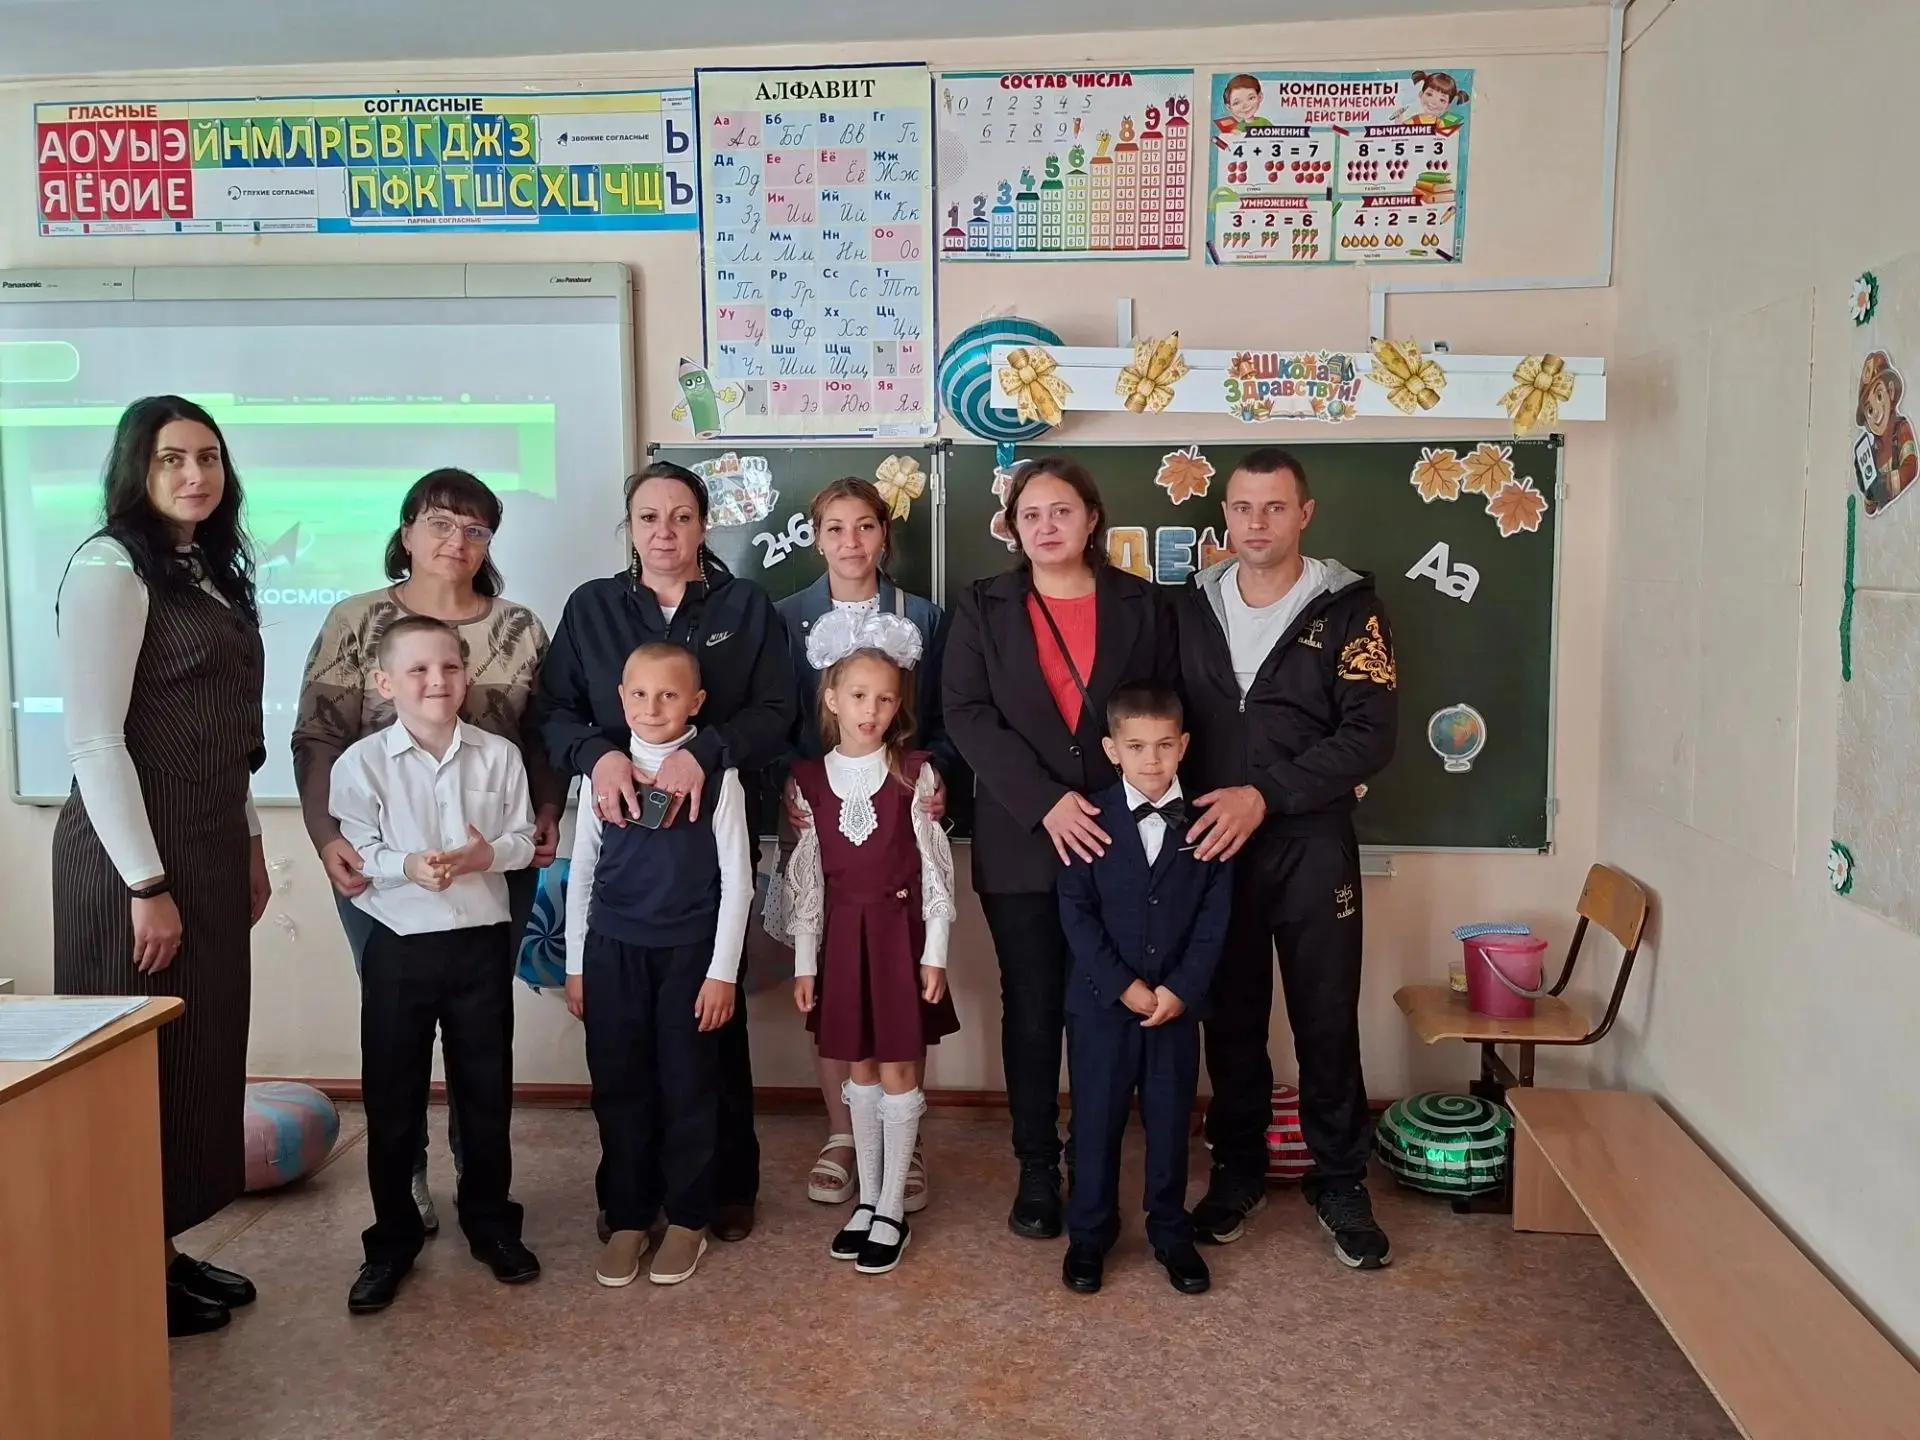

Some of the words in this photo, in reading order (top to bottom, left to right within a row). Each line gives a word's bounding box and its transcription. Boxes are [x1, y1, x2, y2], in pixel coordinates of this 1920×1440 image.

[1000, 75, 1067, 89] СОСТАВ
[1072, 73, 1133, 88] ЧИСЛА
[755, 80, 875, 100] АЛФАВИТ
[1280, 82, 1398, 95] КОМПОНЕНТЫ
[364, 99, 483, 113] СОГЛАСНЫЕ
[958, 97, 968, 111] 0
[986, 97, 992, 111] 1
[1008, 96, 1018, 110] 2
[1033, 96, 1043, 110] 3
[1059, 96, 1067, 109] 4
[1083, 95, 1092, 108] 5
[1165, 98, 1189, 116] 10
[1281, 96, 1395, 108] МАТЕМАТИЧЕСКИХ
[68, 105, 157, 119] ГЛАСНЫЕ
[714, 116, 730, 125] Аа
[765, 114, 782, 125] Бб
[820, 113, 834, 123] Вв
[873, 112, 885, 122] Гг
[1145, 106, 1161, 130] 9
[1305, 111, 1370, 123] ДЕЙСТВИЙ
[605, 133, 649, 141] СОГЛАСНЫЕ
[666, 120, 689, 153] Ь
[983, 124, 992, 138] 6
[1009, 124, 1017, 137] 7
[1033, 123, 1042, 137] 8
[1059, 123, 1067, 136] 9
[1119, 119, 1135, 142] 8
[1250, 128, 1306, 136] СЛОЖЕНИЕ
[1370, 126, 1431, 136] ВЫЧИТАНИЕ
[1096, 133, 1112, 156] 7
[1233, 145, 1243, 158] 4
[1272, 145, 1280, 157] 3
[1309, 145, 1318, 157] 7
[1359, 144, 1368, 156] 8
[1395, 143, 1404, 156] 5
[1434, 142, 1443, 155] 3
[714, 155, 734, 166] Дд
[767, 154, 781, 163] Ее
[821, 151, 836, 163] Ёё
[874, 151, 898, 161] Жж
[1068, 148, 1085, 168] 6
[1045, 158, 1060, 178] 5
[1020, 170, 1036, 191] 4
[666, 172, 693, 205] Ъ
[997, 183, 1012, 204] 3
[716, 195, 731, 204] Зз
[768, 194, 784, 203] Ии
[822, 189, 839, 201] Йй
[874, 191, 891, 200] Кк
[1243, 199, 1305, 207] УМНОЖЕНИЕ
[1371, 197, 1416, 206] ДЕЛЕНИЕ
[973, 196, 986, 216] 2
[948, 206, 958, 227] 1
[1233, 215, 1242, 227] 3
[1265, 214, 1274, 227] 2
[1303, 214, 1312, 226] 6
[1354, 214, 1364, 226] 4
[1388, 213, 1398, 225] 2
[1427, 213, 1436, 225] 2
[717, 232, 734, 241] Лл
[770, 231, 791, 241] Мм
[823, 230, 839, 240] Нн
[875, 229, 893, 238] Оо
[718, 271, 734, 280] Пп
[771, 271, 787, 281] Рр
[823, 269, 838, 278] Сс
[876, 268, 889, 278] Тт
[720, 309, 735, 319] Уу
[771, 308, 793, 319] Фф
[825, 307, 839, 316] Хх
[877, 307, 895, 317] Цц
[720, 345, 736, 354] Чч
[772, 345, 795, 354] Шш
[825, 344, 851, 355] Щщ
[772, 382, 788, 391] Ээ
[826, 382, 851, 391] Юю
[878, 380, 893, 390] Яя
[1224, 378, 1361, 402] Здравствуй!
